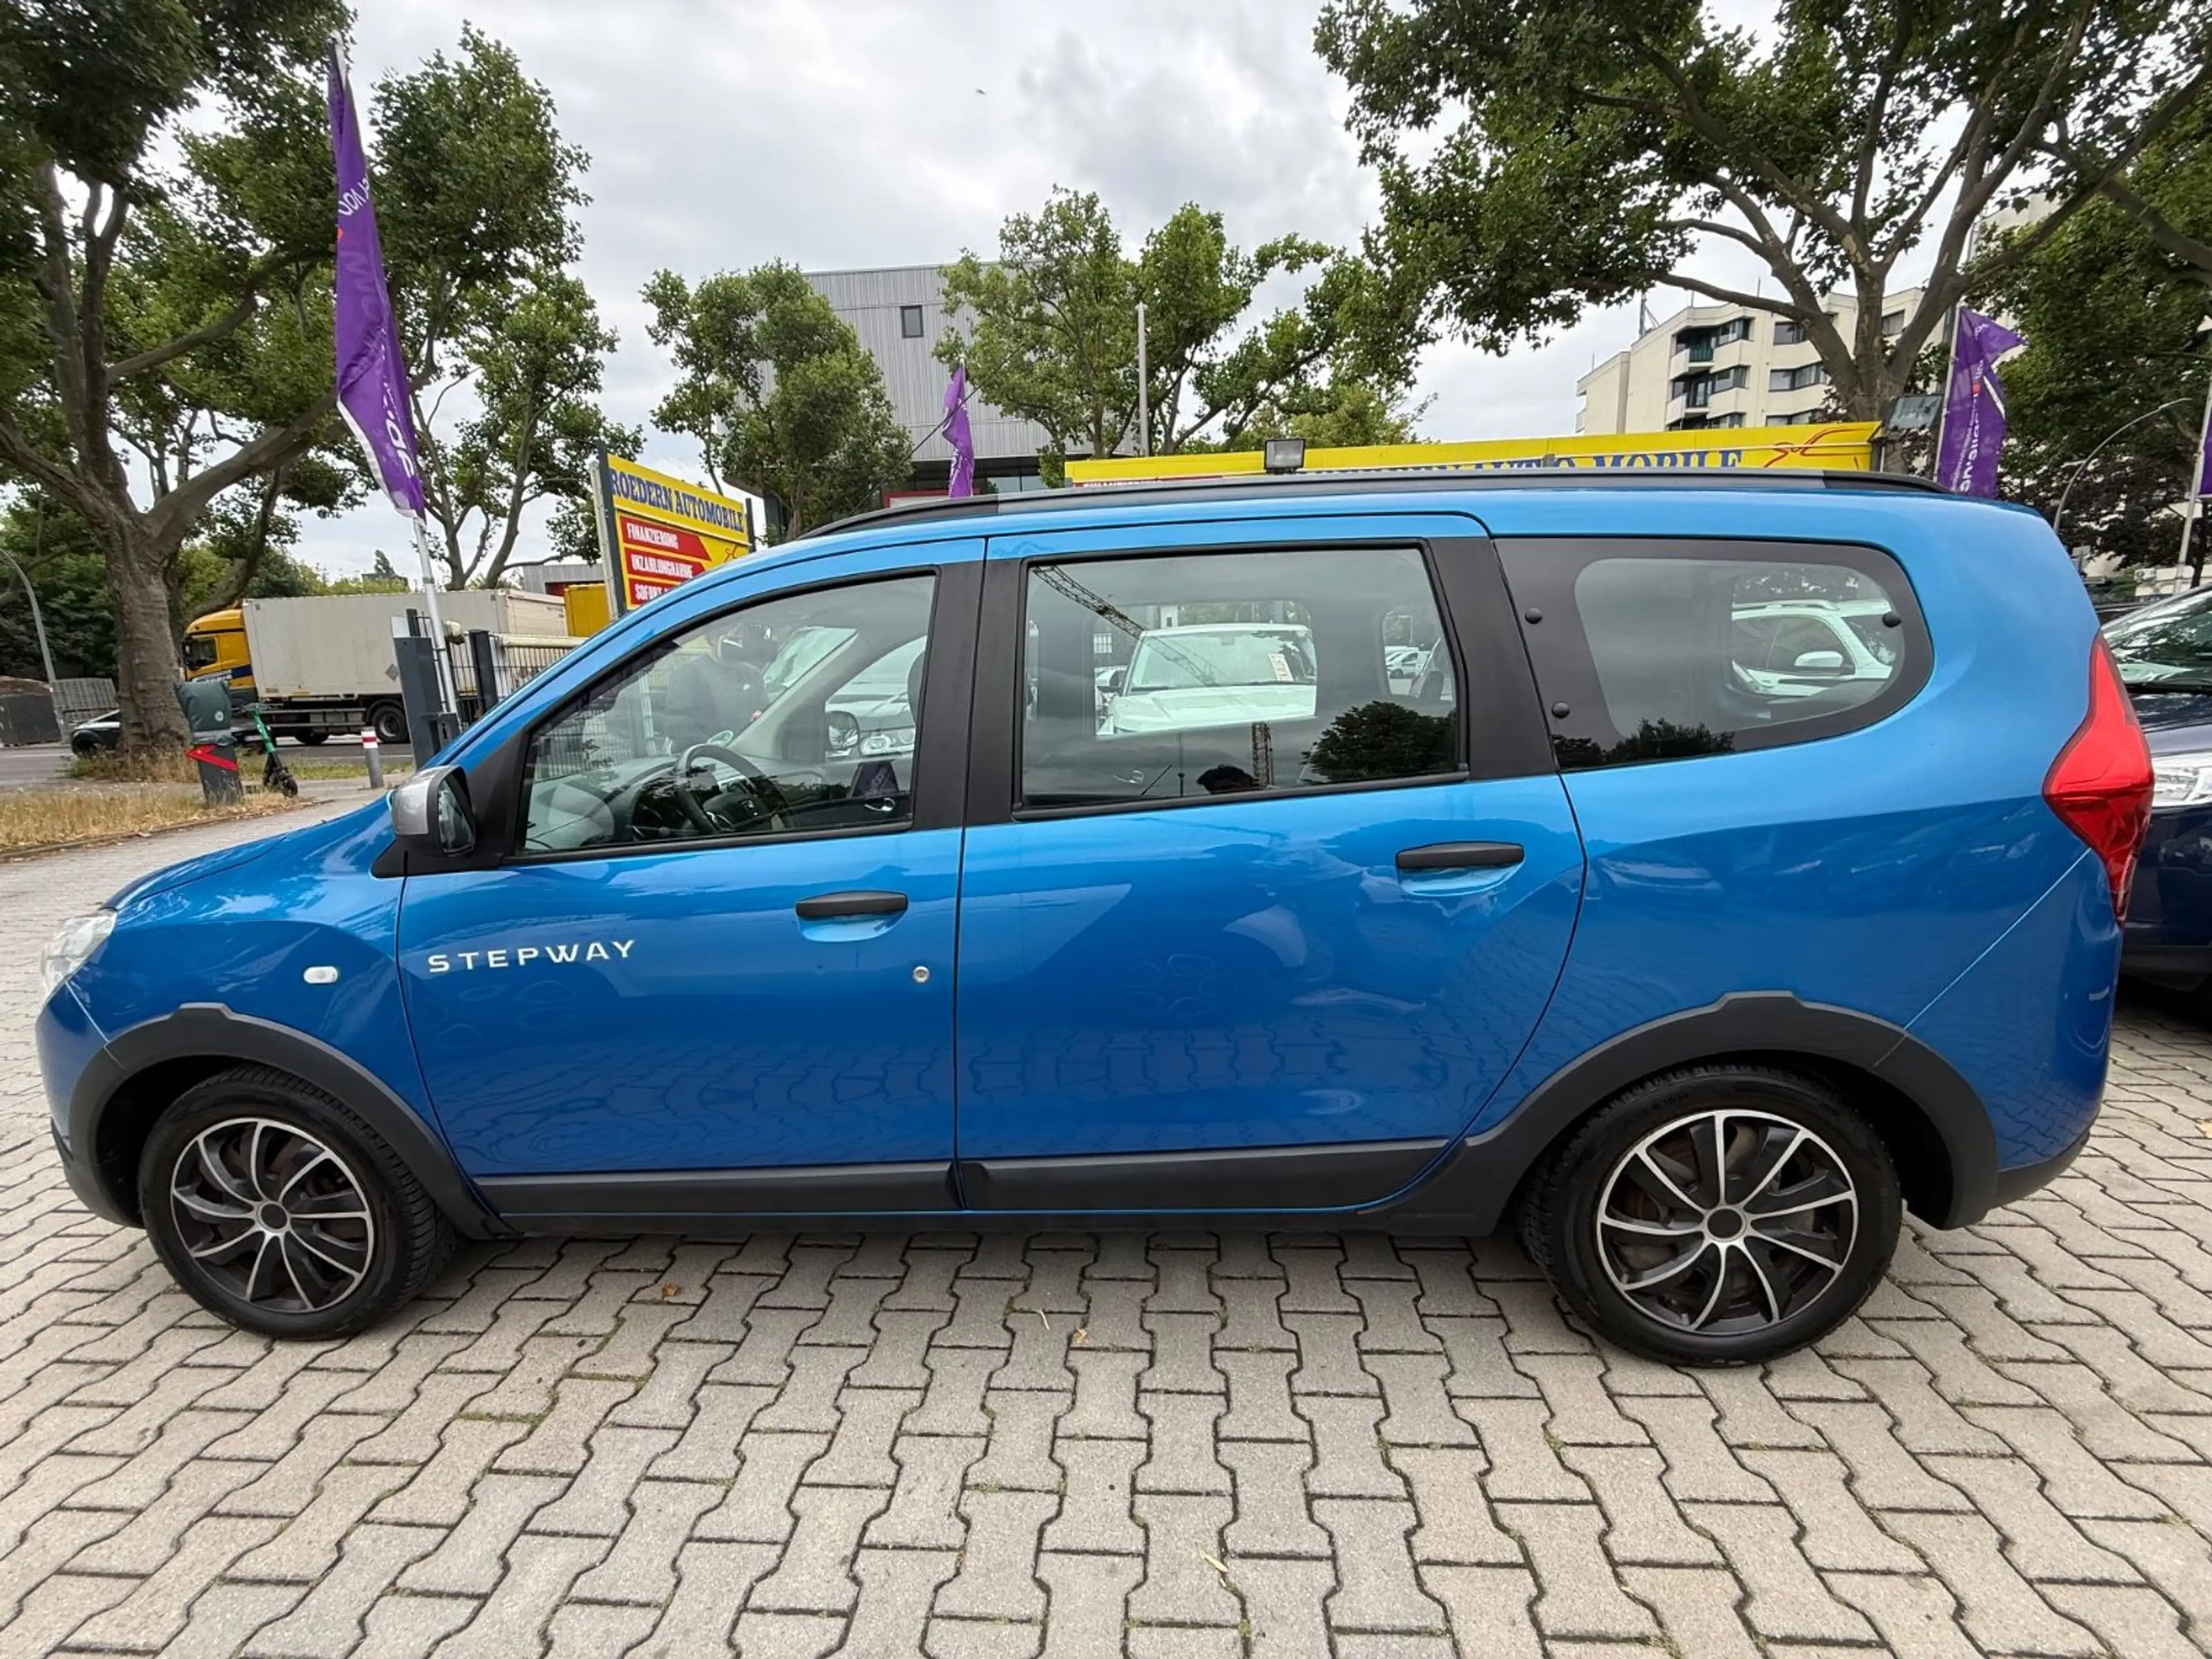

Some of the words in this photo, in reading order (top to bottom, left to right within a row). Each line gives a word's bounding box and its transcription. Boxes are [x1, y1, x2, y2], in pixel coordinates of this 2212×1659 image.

[609, 469, 673, 512] ROEDERN
[675, 490, 745, 532] AUTOMOBILE
[428, 940, 637, 974] STEPWAY
